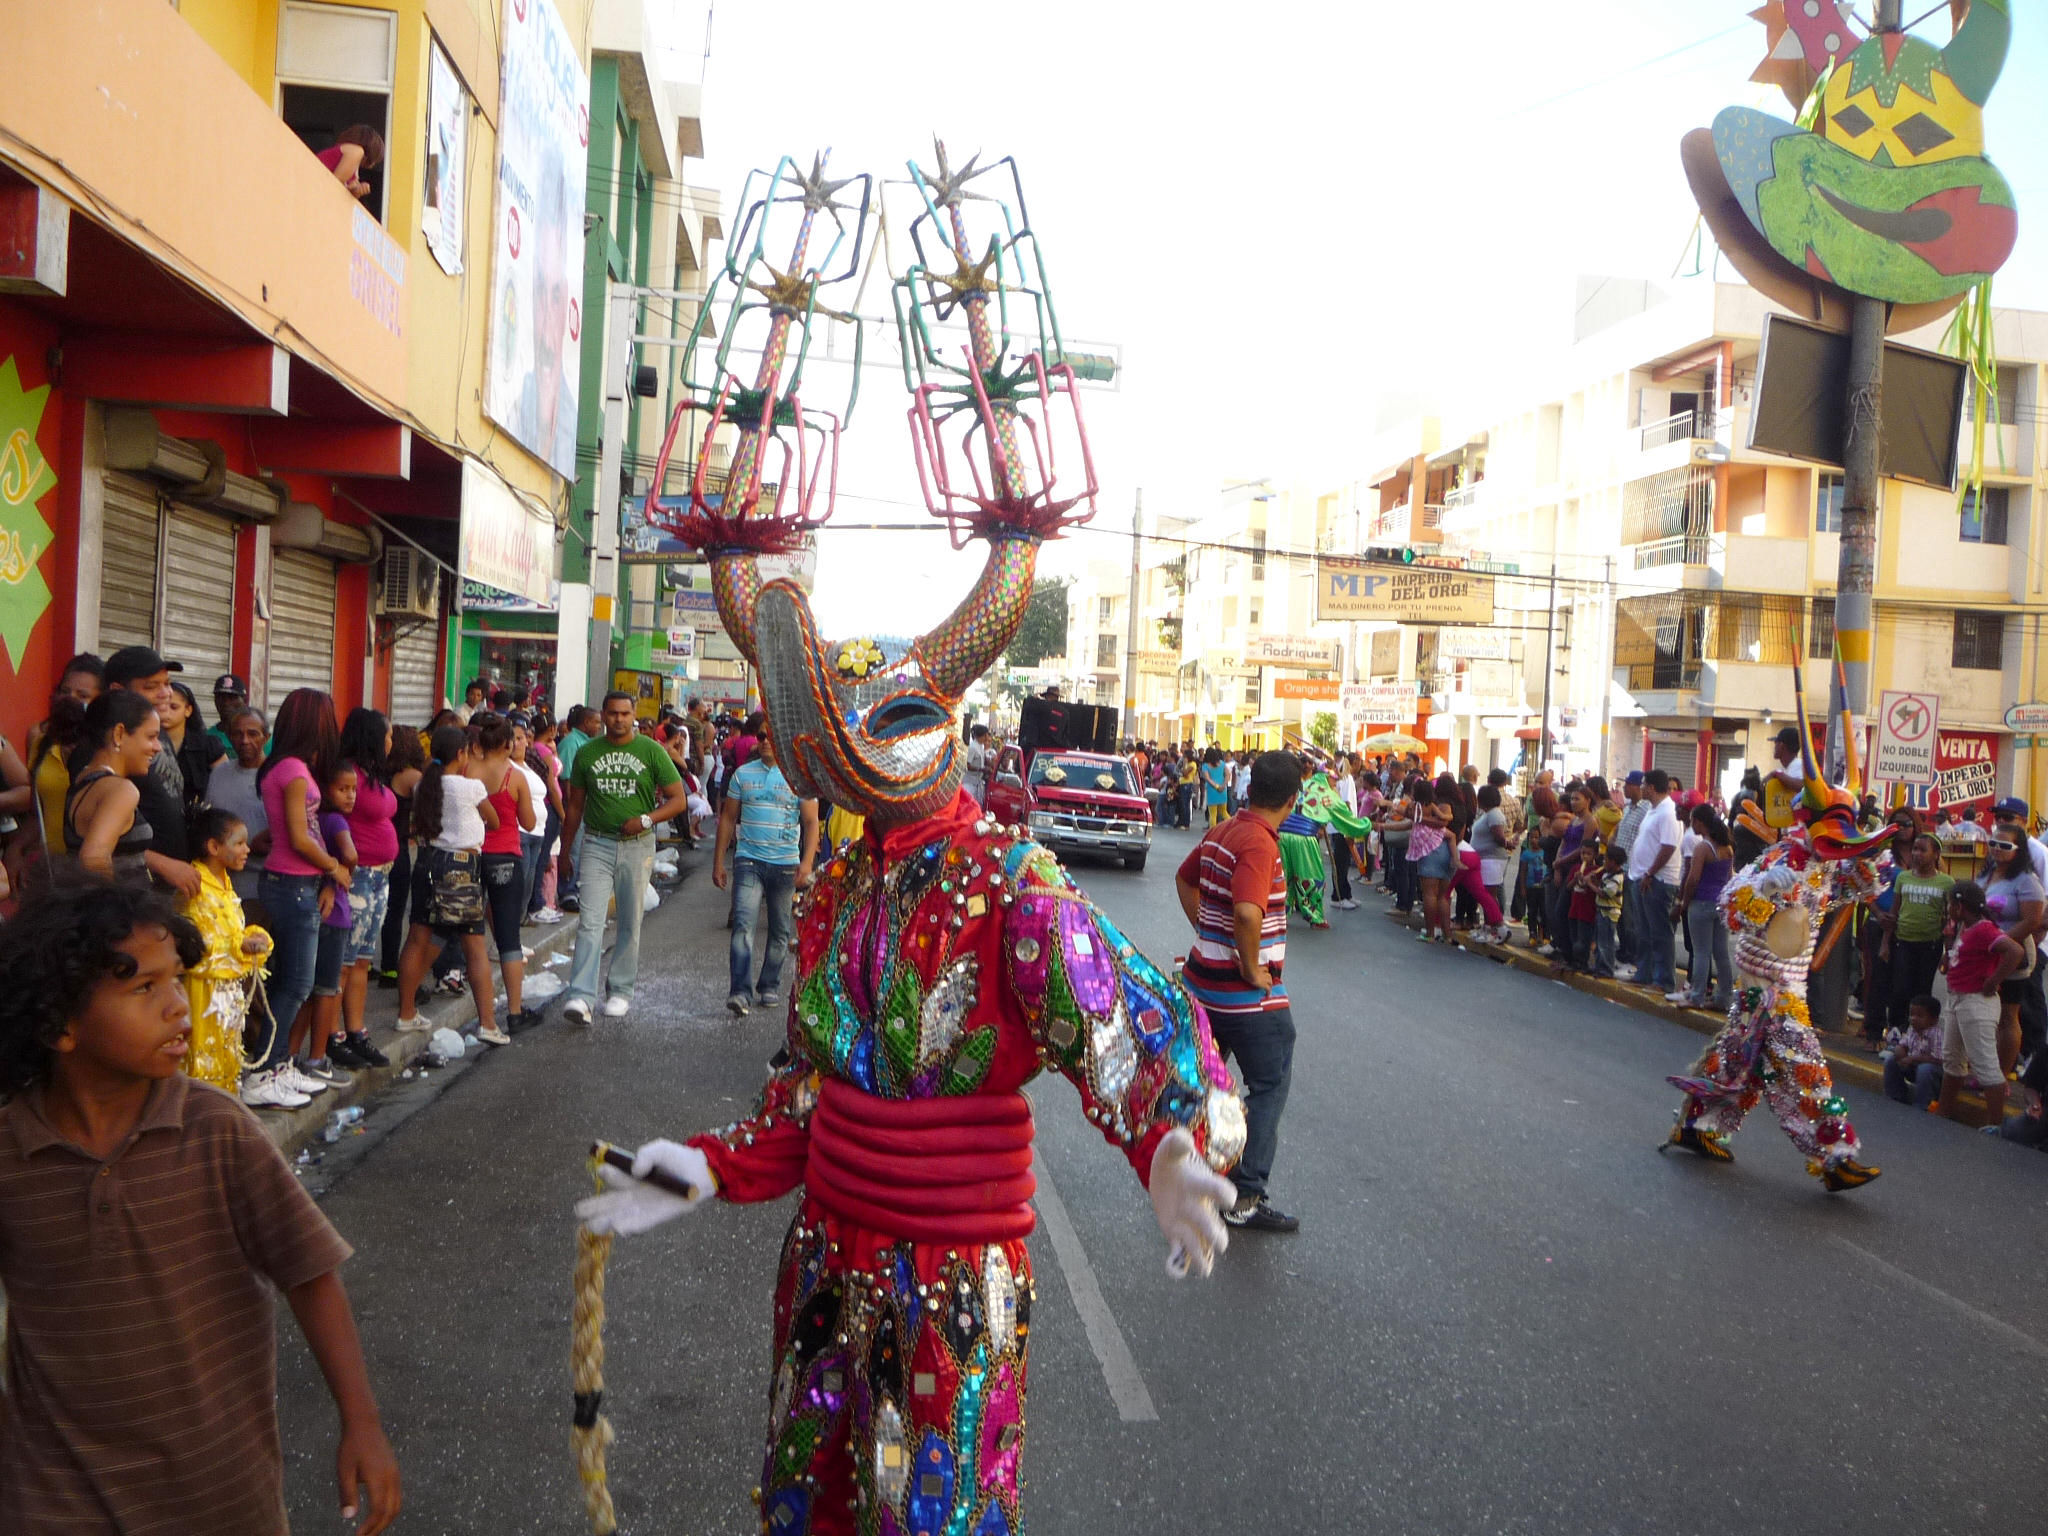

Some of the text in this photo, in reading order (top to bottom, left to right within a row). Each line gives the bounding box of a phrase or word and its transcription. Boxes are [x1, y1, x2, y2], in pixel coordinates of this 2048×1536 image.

[1330, 572, 1451, 597] MP IMPERIO
[1391, 585, 1425, 602] DEL
[1328, 602, 1349, 610] MAS
[1388, 603, 1407, 611] POR
[1425, 604, 1463, 612] PRENDA
[1284, 682, 1320, 695] Orange
[1343, 687, 1415, 696] JOYERIA COMPRA VENTA
[1882, 745, 1929, 759] NO DOBLE
[1939, 737, 1991, 760] VENTA
[606, 765, 629, 775] AND
[1879, 761, 1929, 775] IZQUIERDA
[1939, 762, 1993, 787] IMPERIO
[1940, 777, 1994, 804] DEL ORO!
